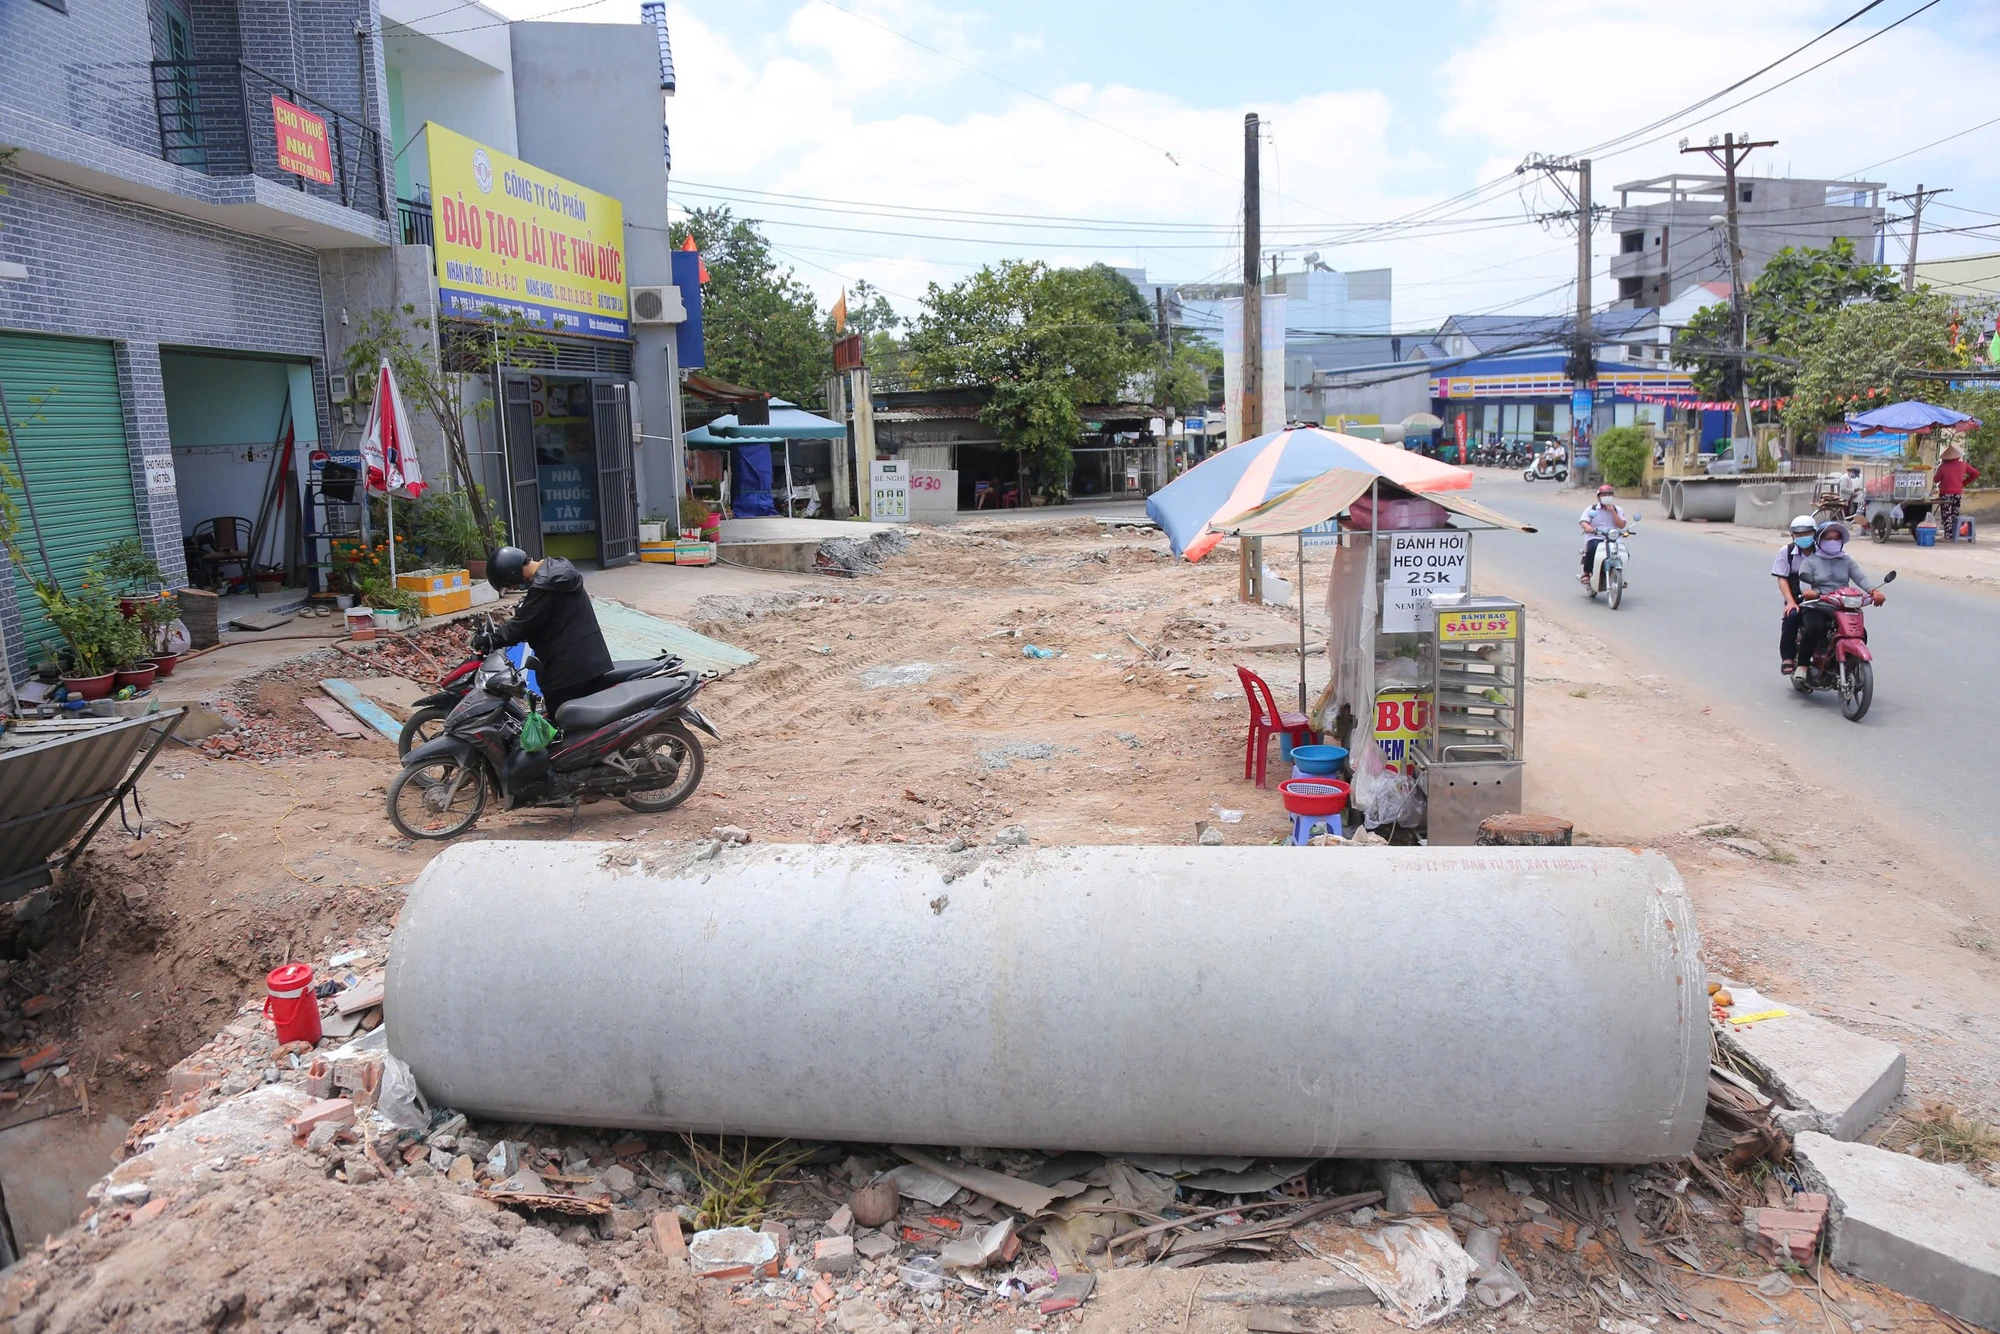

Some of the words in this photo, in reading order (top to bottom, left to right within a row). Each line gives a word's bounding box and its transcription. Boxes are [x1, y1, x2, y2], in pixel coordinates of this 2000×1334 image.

[276, 106, 298, 129] CHO
[299, 117, 324, 141] THUÊ
[285, 135, 316, 162] NHÀ
[503, 169, 533, 203] CÔNG
[533, 182, 546, 207] TY
[547, 183, 561, 213] CỔ
[562, 191, 587, 222] PHẦN
[441, 190, 483, 250] ĐÀO
[485, 209, 519, 266] TẠO
[521, 216, 547, 267] LÁI
[549, 229, 569, 272] XE
[569, 229, 596, 279] THỦ
[597, 240, 622, 285] ĐỨC
[446, 258, 465, 285] NHẬN
[464, 260, 474, 284] HỒ
[330, 455, 361, 463] PEPSI
[551, 467, 582, 482] NHÀ
[544, 484, 592, 501] THUỐC
[555, 504, 582, 519] TÂY
[1396, 535, 1436, 550] BÁNH
[1439, 535, 1463, 549] HỎI
[1393, 555, 1424, 568] HEO
[1426, 554, 1465, 569] QUAY
[1406, 571, 1451, 584] 25k
[1410, 585, 1434, 597] BÚN
[1394, 602, 1415, 610] NEM
[1461, 612, 1486, 620] BÁNH
